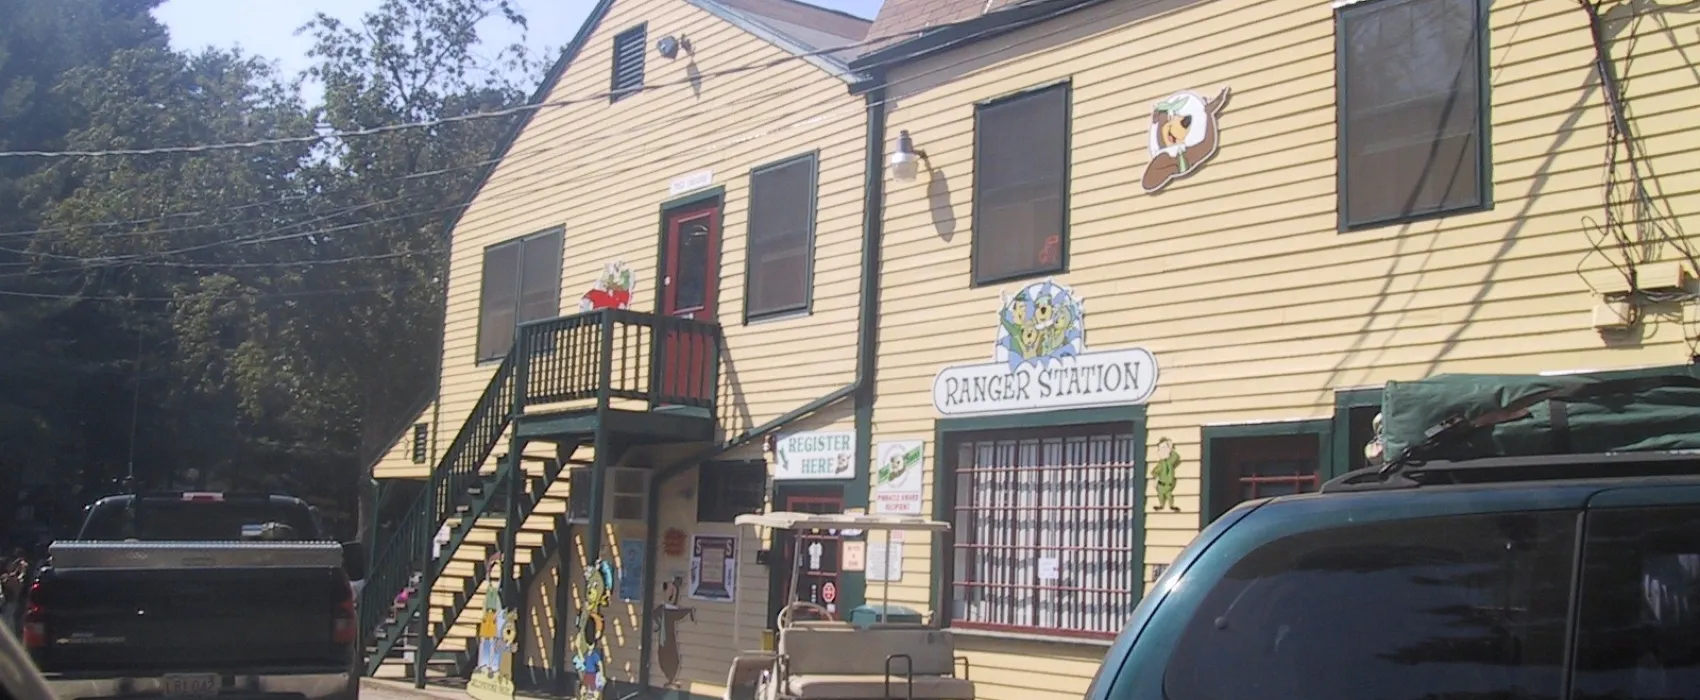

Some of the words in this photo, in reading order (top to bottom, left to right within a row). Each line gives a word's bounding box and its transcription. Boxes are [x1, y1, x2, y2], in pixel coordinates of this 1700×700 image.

[945, 370, 1030, 406] RANGER
[1038, 361, 1140, 398] STATION
[788, 435, 850, 453] REGISTER
[801, 457, 834, 474] HERE
